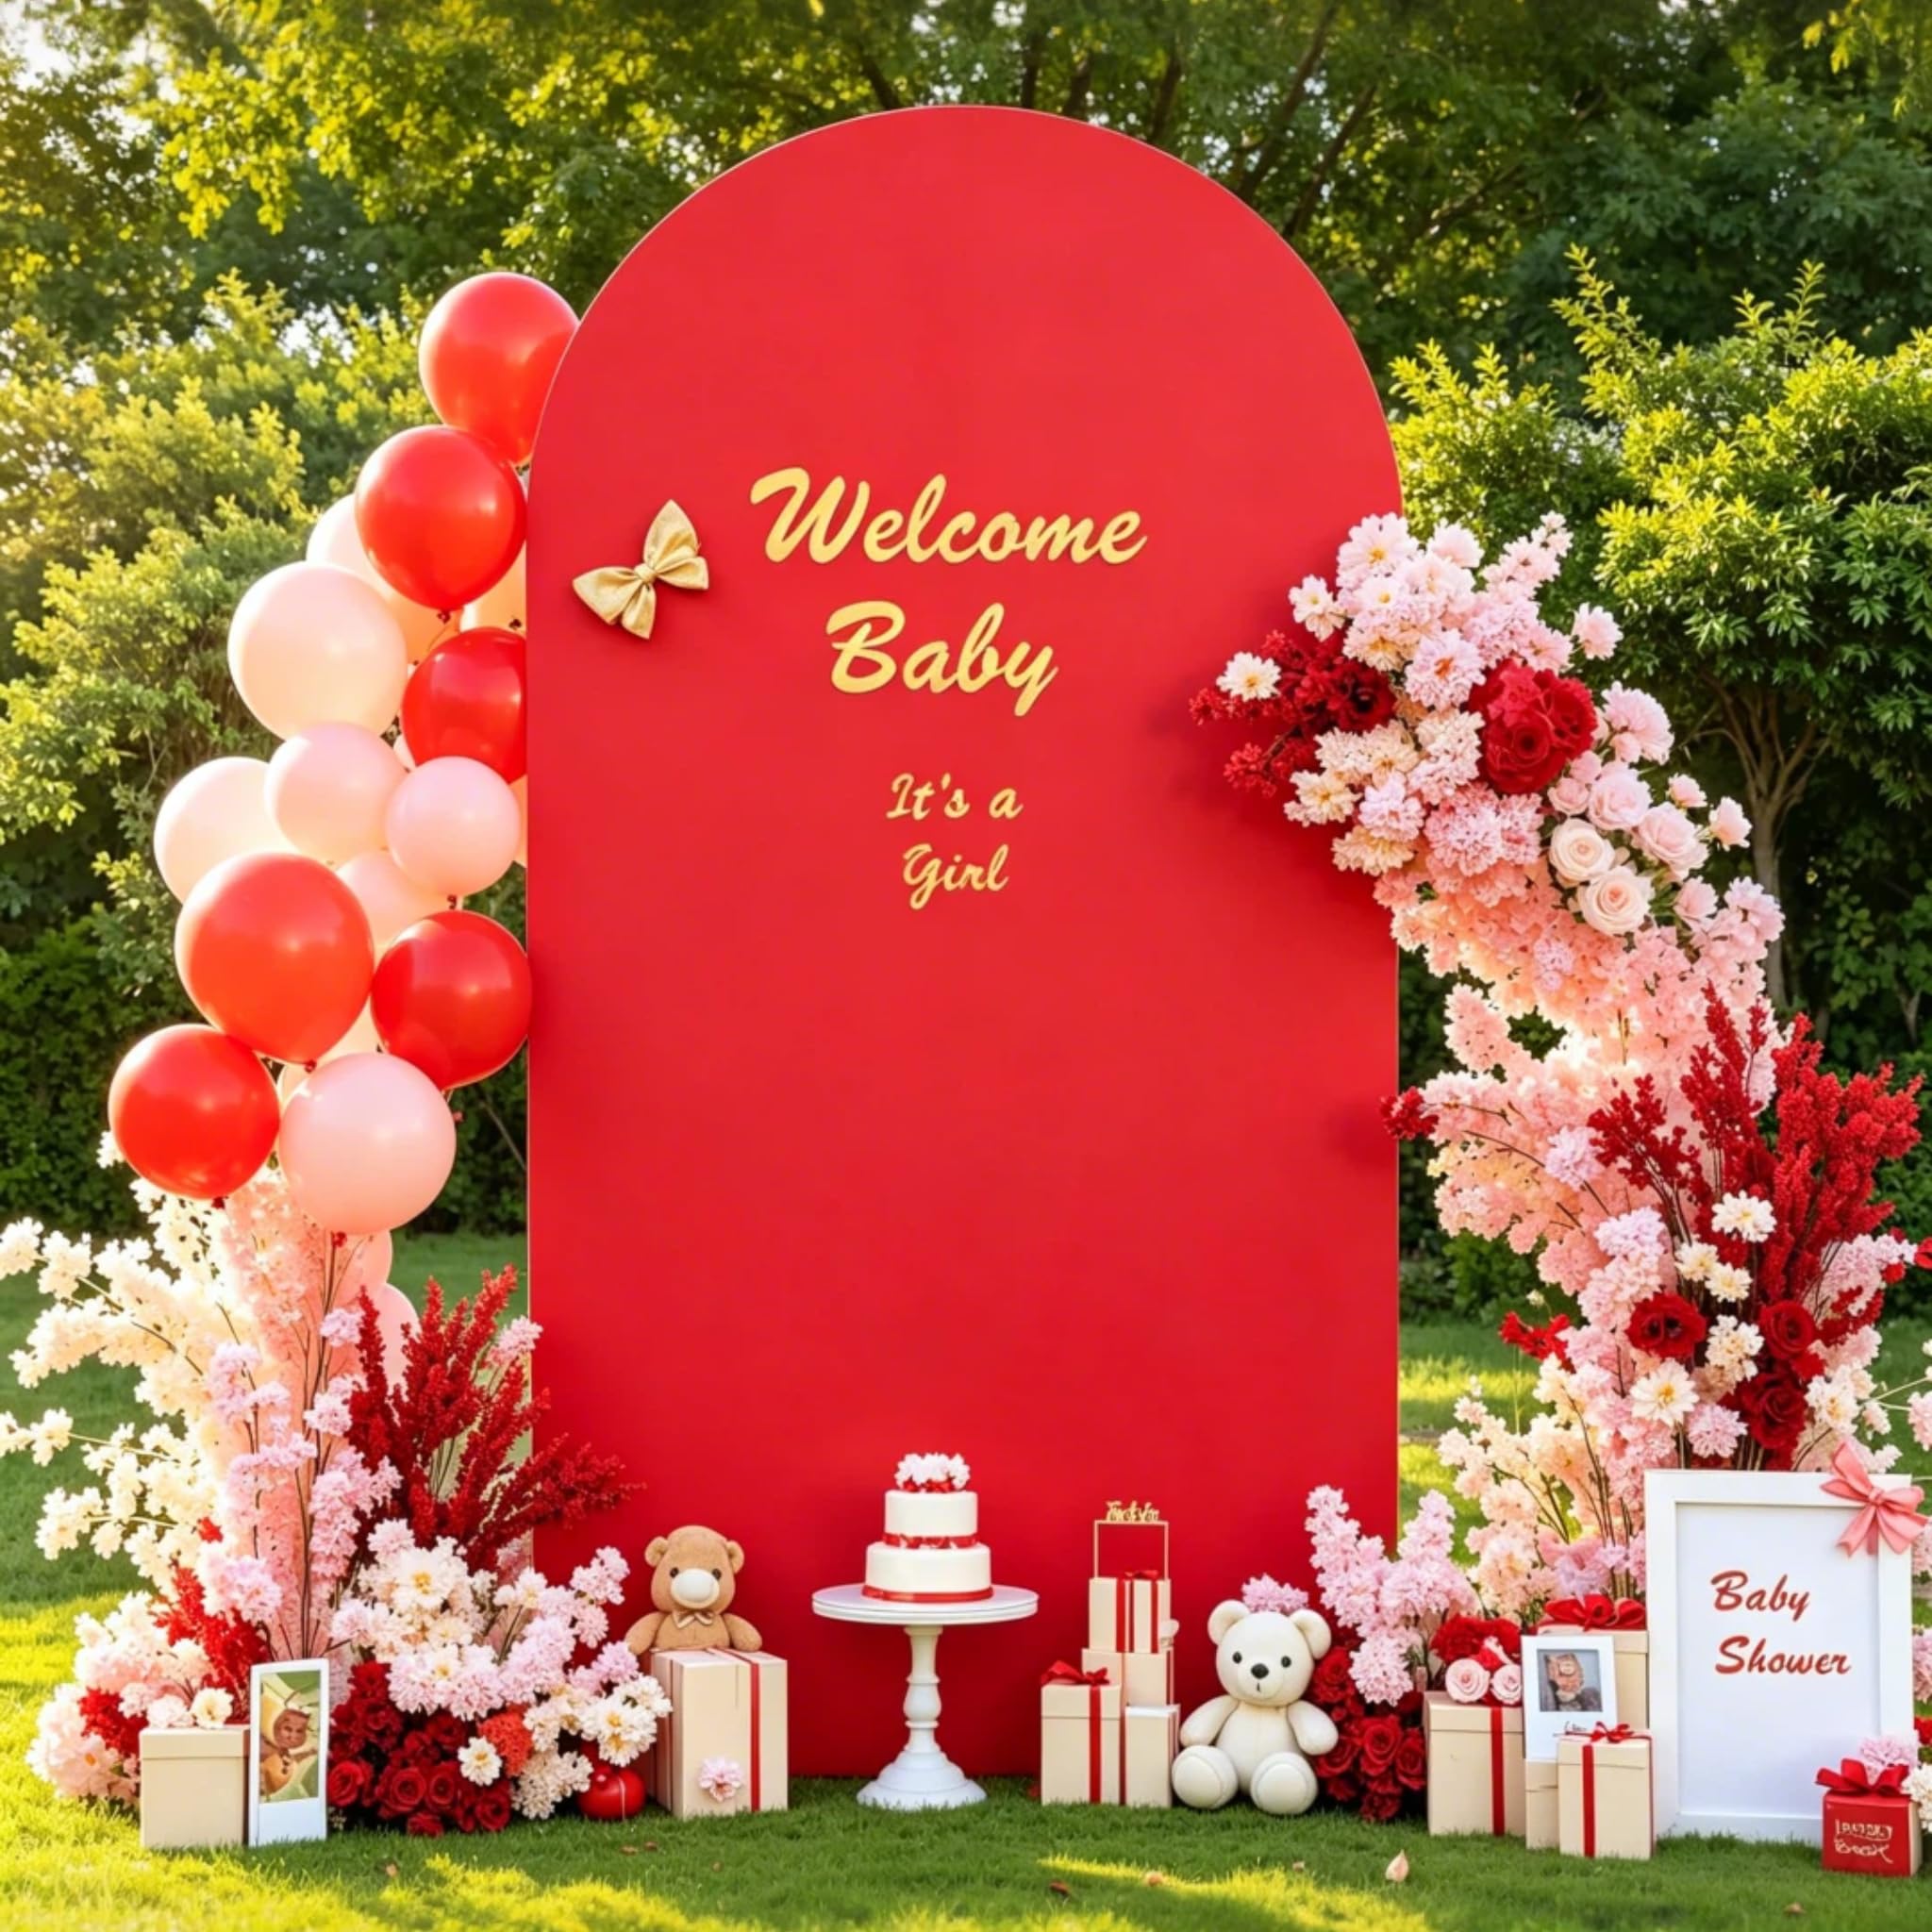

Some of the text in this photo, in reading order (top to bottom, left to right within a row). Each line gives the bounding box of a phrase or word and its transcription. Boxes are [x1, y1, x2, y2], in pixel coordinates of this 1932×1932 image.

[749, 467, 1148, 564] Welcome
[825, 600, 1058, 717] Baby
[886, 773, 1024, 821] It's a
[903, 843, 1009, 910] Girl
[1710, 1570, 1810, 1623] Baby
[1714, 1635, 1852, 1675] Shower
